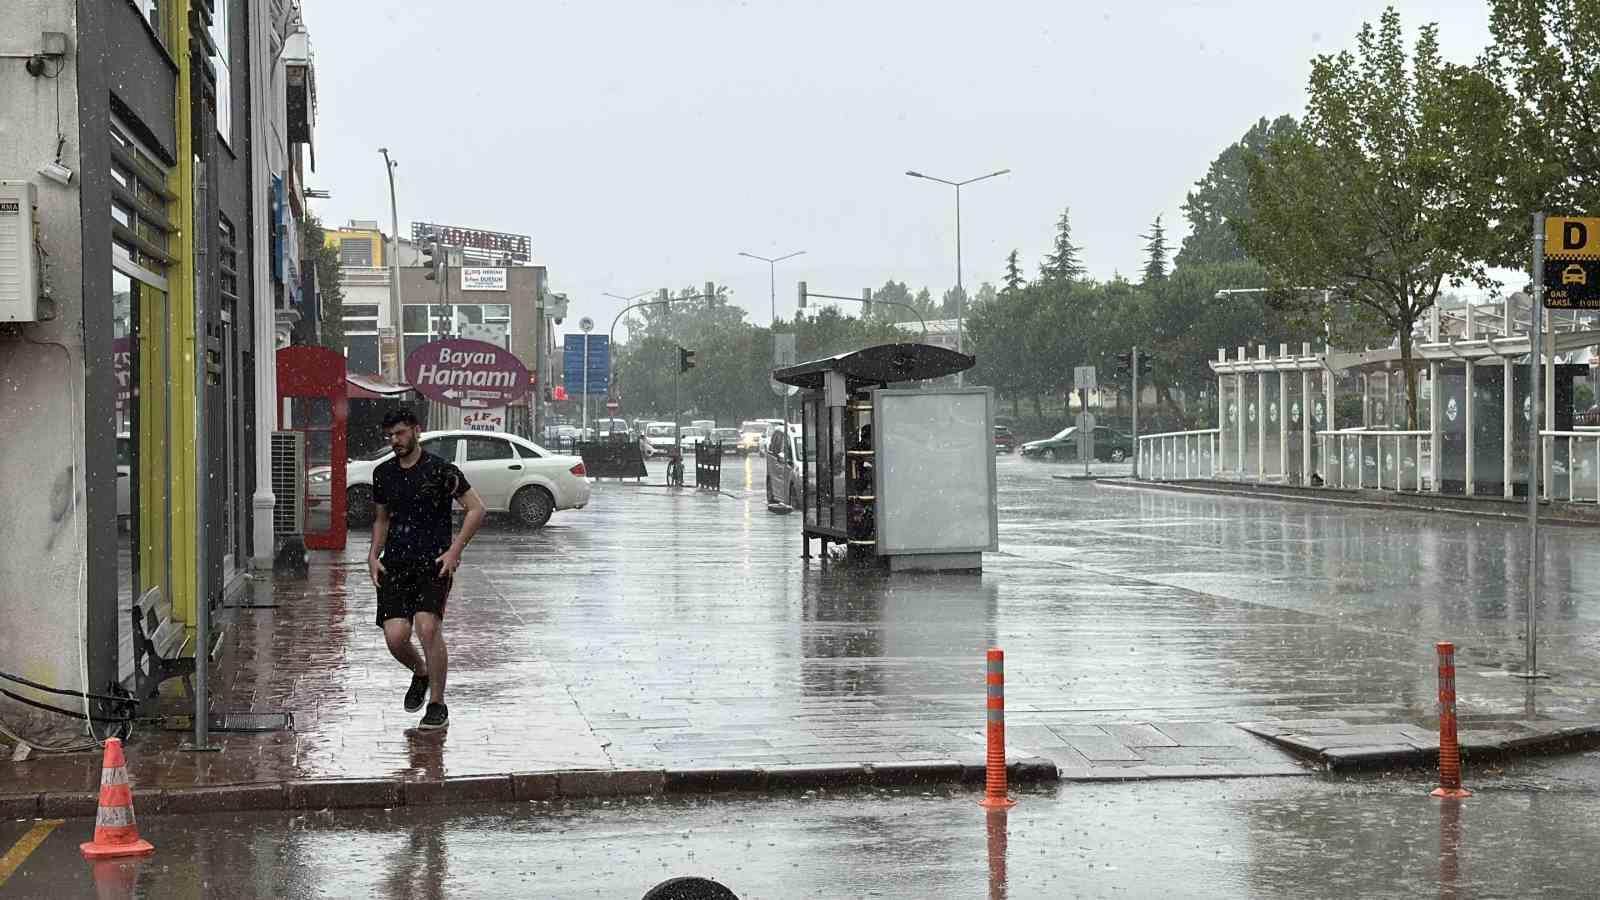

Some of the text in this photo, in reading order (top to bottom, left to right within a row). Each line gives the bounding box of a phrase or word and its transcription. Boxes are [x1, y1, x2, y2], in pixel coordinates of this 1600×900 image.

[1563, 222, 1588, 250] D
[439, 347, 496, 368] Bayan
[417, 364, 517, 387] Hamamı
